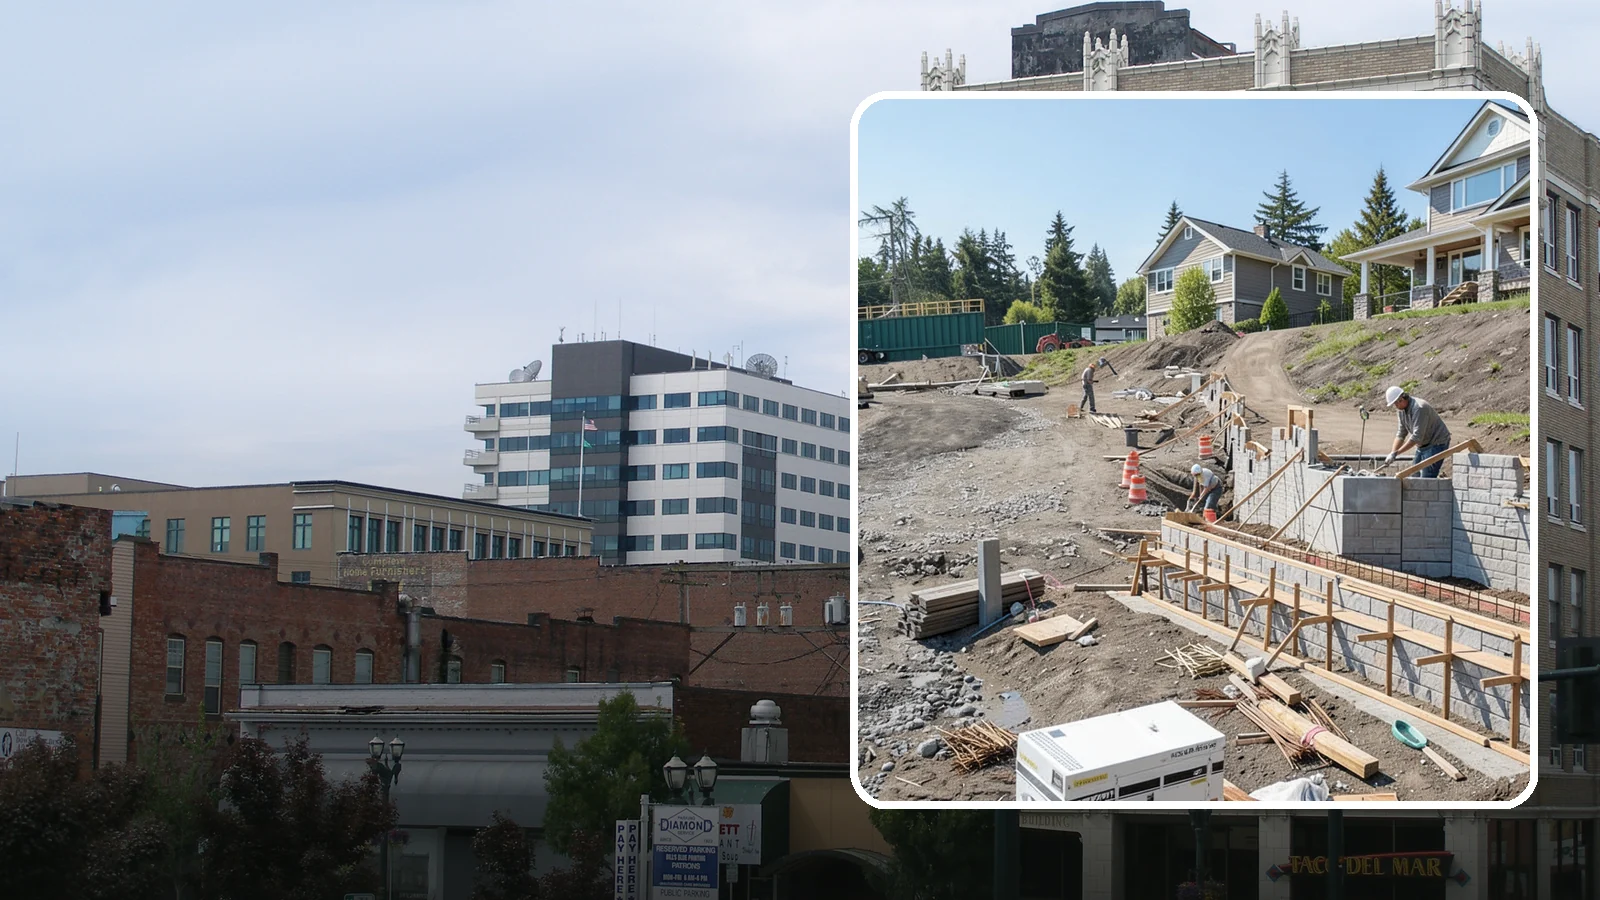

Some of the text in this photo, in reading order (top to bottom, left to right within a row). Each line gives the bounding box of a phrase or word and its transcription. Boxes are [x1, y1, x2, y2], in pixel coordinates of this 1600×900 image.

[362, 556, 406, 567] Complete
[343, 566, 427, 577] Home Furnishers
[660, 818, 713, 832] DIAMOND
[1021, 815, 1070, 828] BUILDING
[656, 845, 716, 854] RESERVED PARKING
[616, 825, 625, 894] PAY HERE
[627, 824, 637, 893] PAY HERE
[721, 851, 739, 862] Soup
[671, 862, 701, 870] PATRONS
[1346, 856, 1385, 876] DEL
[1392, 857, 1442, 877] MAR
[660, 888, 710, 899] PUBLIC PARKING
